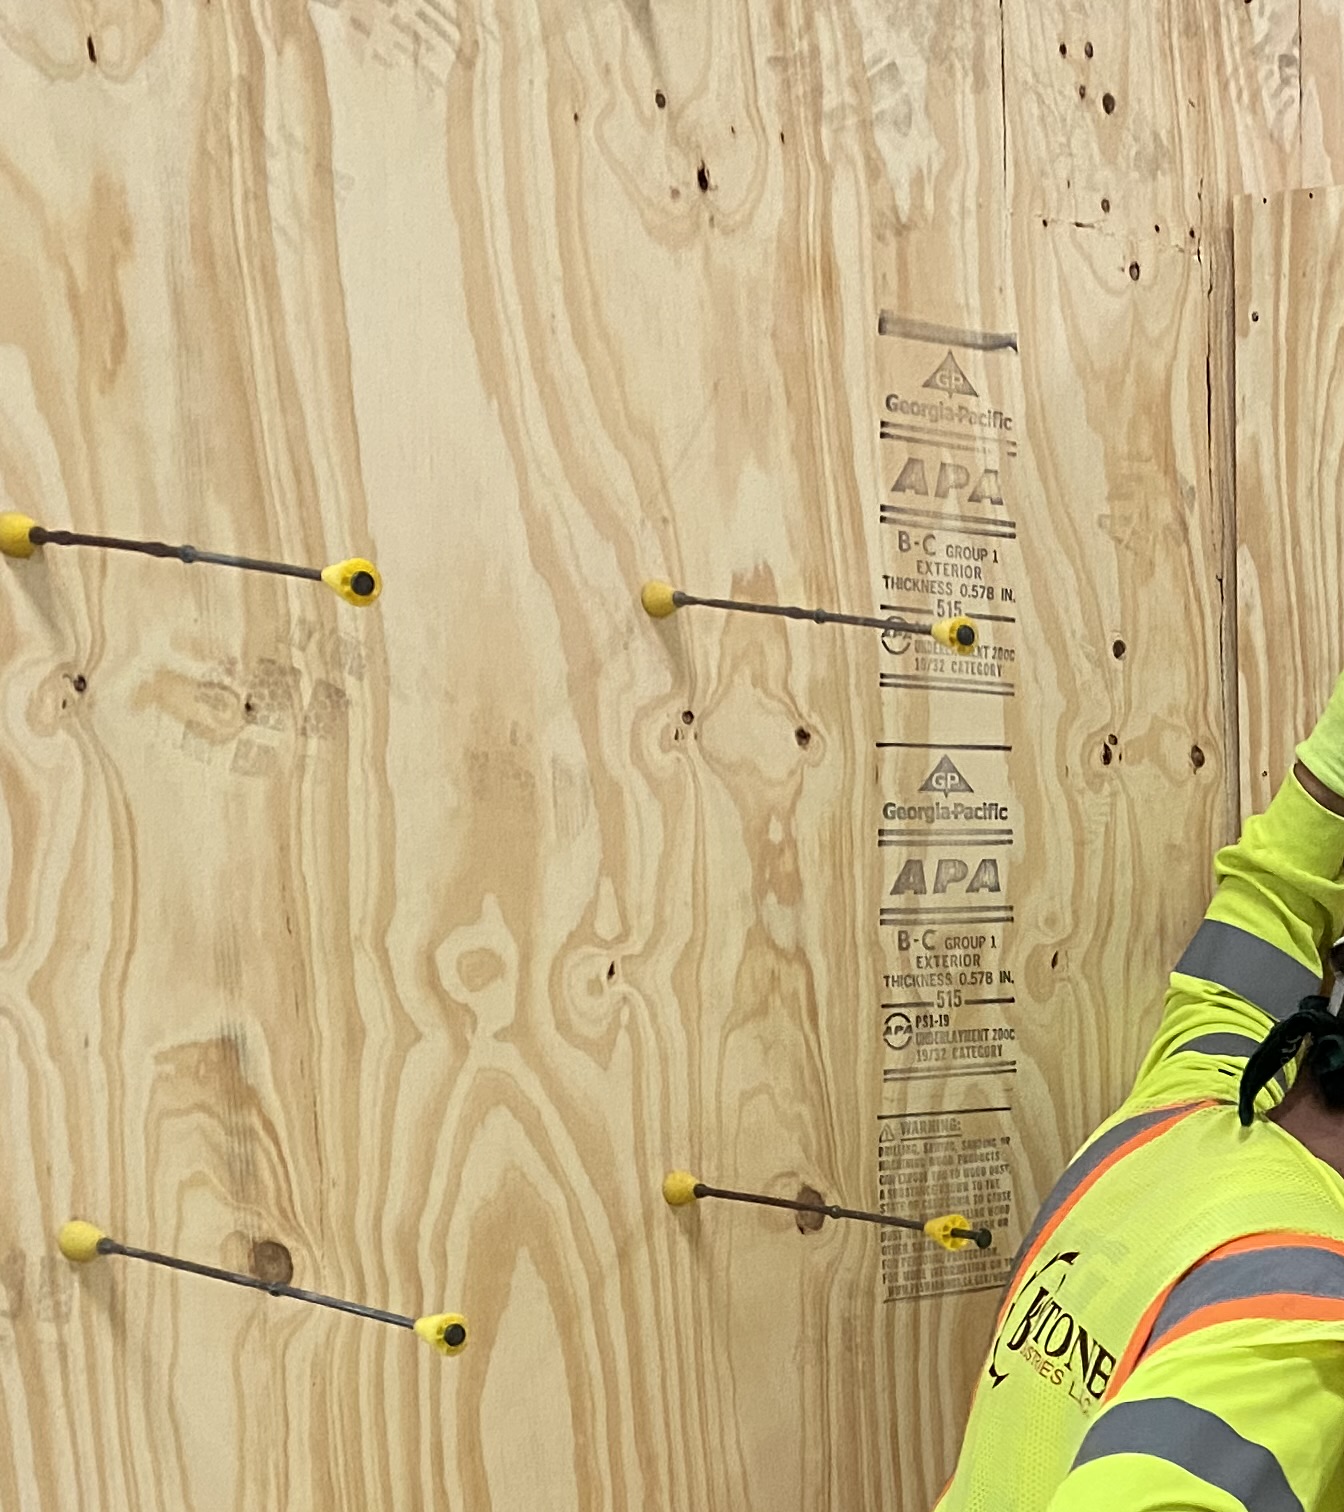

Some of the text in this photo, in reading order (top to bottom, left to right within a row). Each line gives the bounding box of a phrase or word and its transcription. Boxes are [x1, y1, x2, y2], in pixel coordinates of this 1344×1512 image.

[885, 393, 1013, 431] Georgia-Pacific
[890, 456, 1005, 507] APA
[945, 544, 989, 562] GROUP
[992, 549, 999, 564] 1
[916, 559, 983, 581] EXTERIOR
[882, 574, 953, 597] THICKNESS
[960, 583, 995, 601] 0.578
[931, 771, 960, 790] GP
[882, 801, 1009, 824] Georgia-Pacific
[889, 858, 1002, 896] APA
[944, 935, 986, 950] GROUP
[990, 935, 997, 949] 1
[916, 953, 981, 969] EXTERIOR
[883, 972, 953, 988] THICKNESS
[958, 971, 993, 986] 0.578
[883, 1024, 914, 1036] APA
